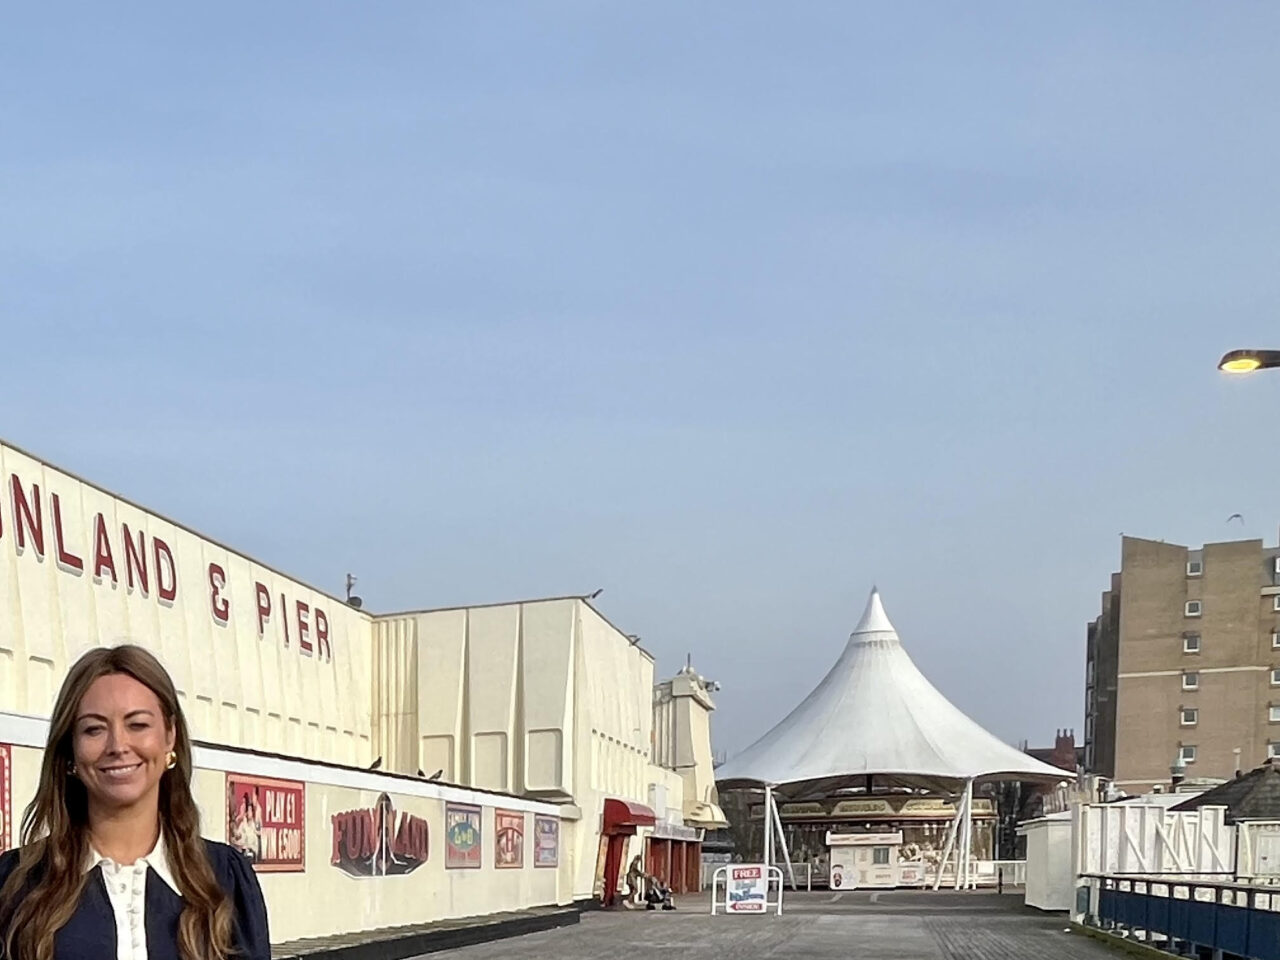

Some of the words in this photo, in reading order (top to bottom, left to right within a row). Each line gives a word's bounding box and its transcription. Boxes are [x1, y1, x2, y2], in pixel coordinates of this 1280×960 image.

[209, 563, 229, 625] &
[255, 581, 331, 662] PIER
[734, 868, 760, 879] FREE
